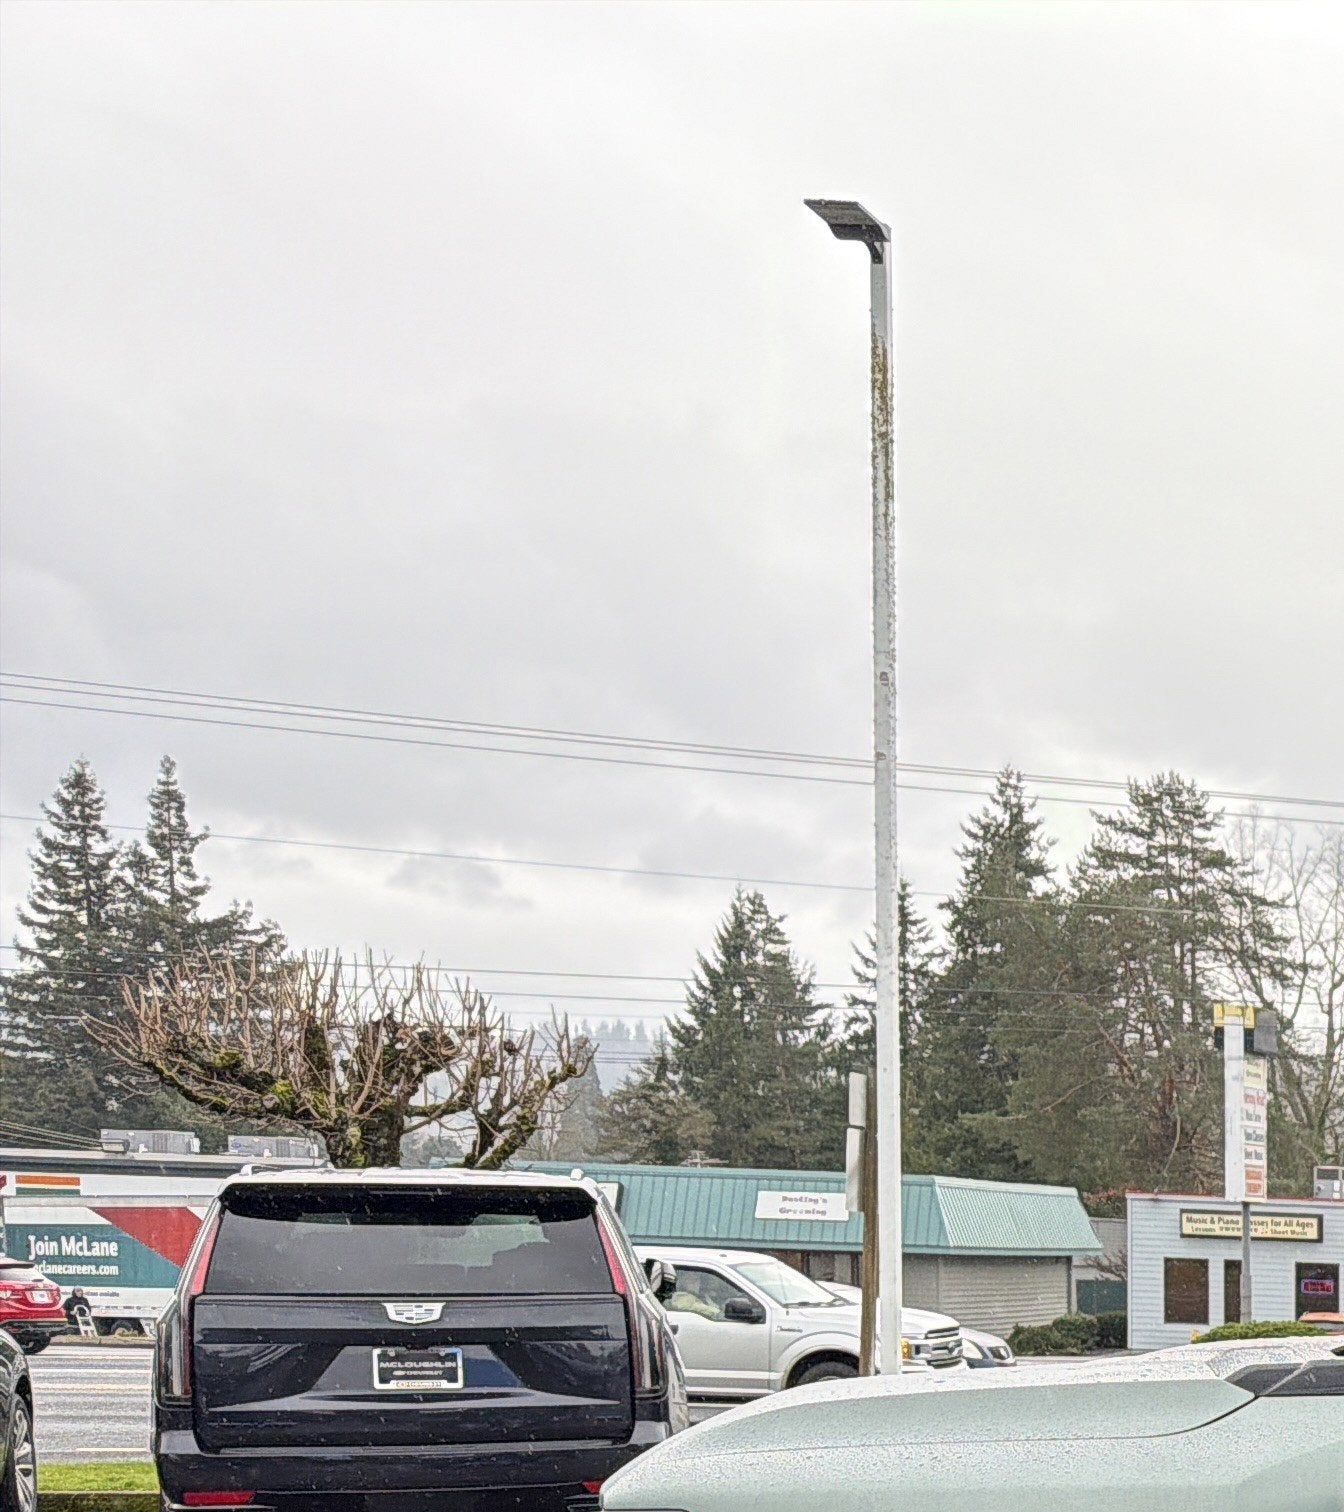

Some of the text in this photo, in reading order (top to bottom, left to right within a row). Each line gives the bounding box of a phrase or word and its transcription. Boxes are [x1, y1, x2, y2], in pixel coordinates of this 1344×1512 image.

[1186, 1216, 1208, 1225] Music
[1218, 1217, 1240, 1226] Piano
[1296, 1220, 1314, 1231] Ages
[28, 1235, 118, 1261] Join McLane
[33, 1260, 119, 1276] clanecareers.com
